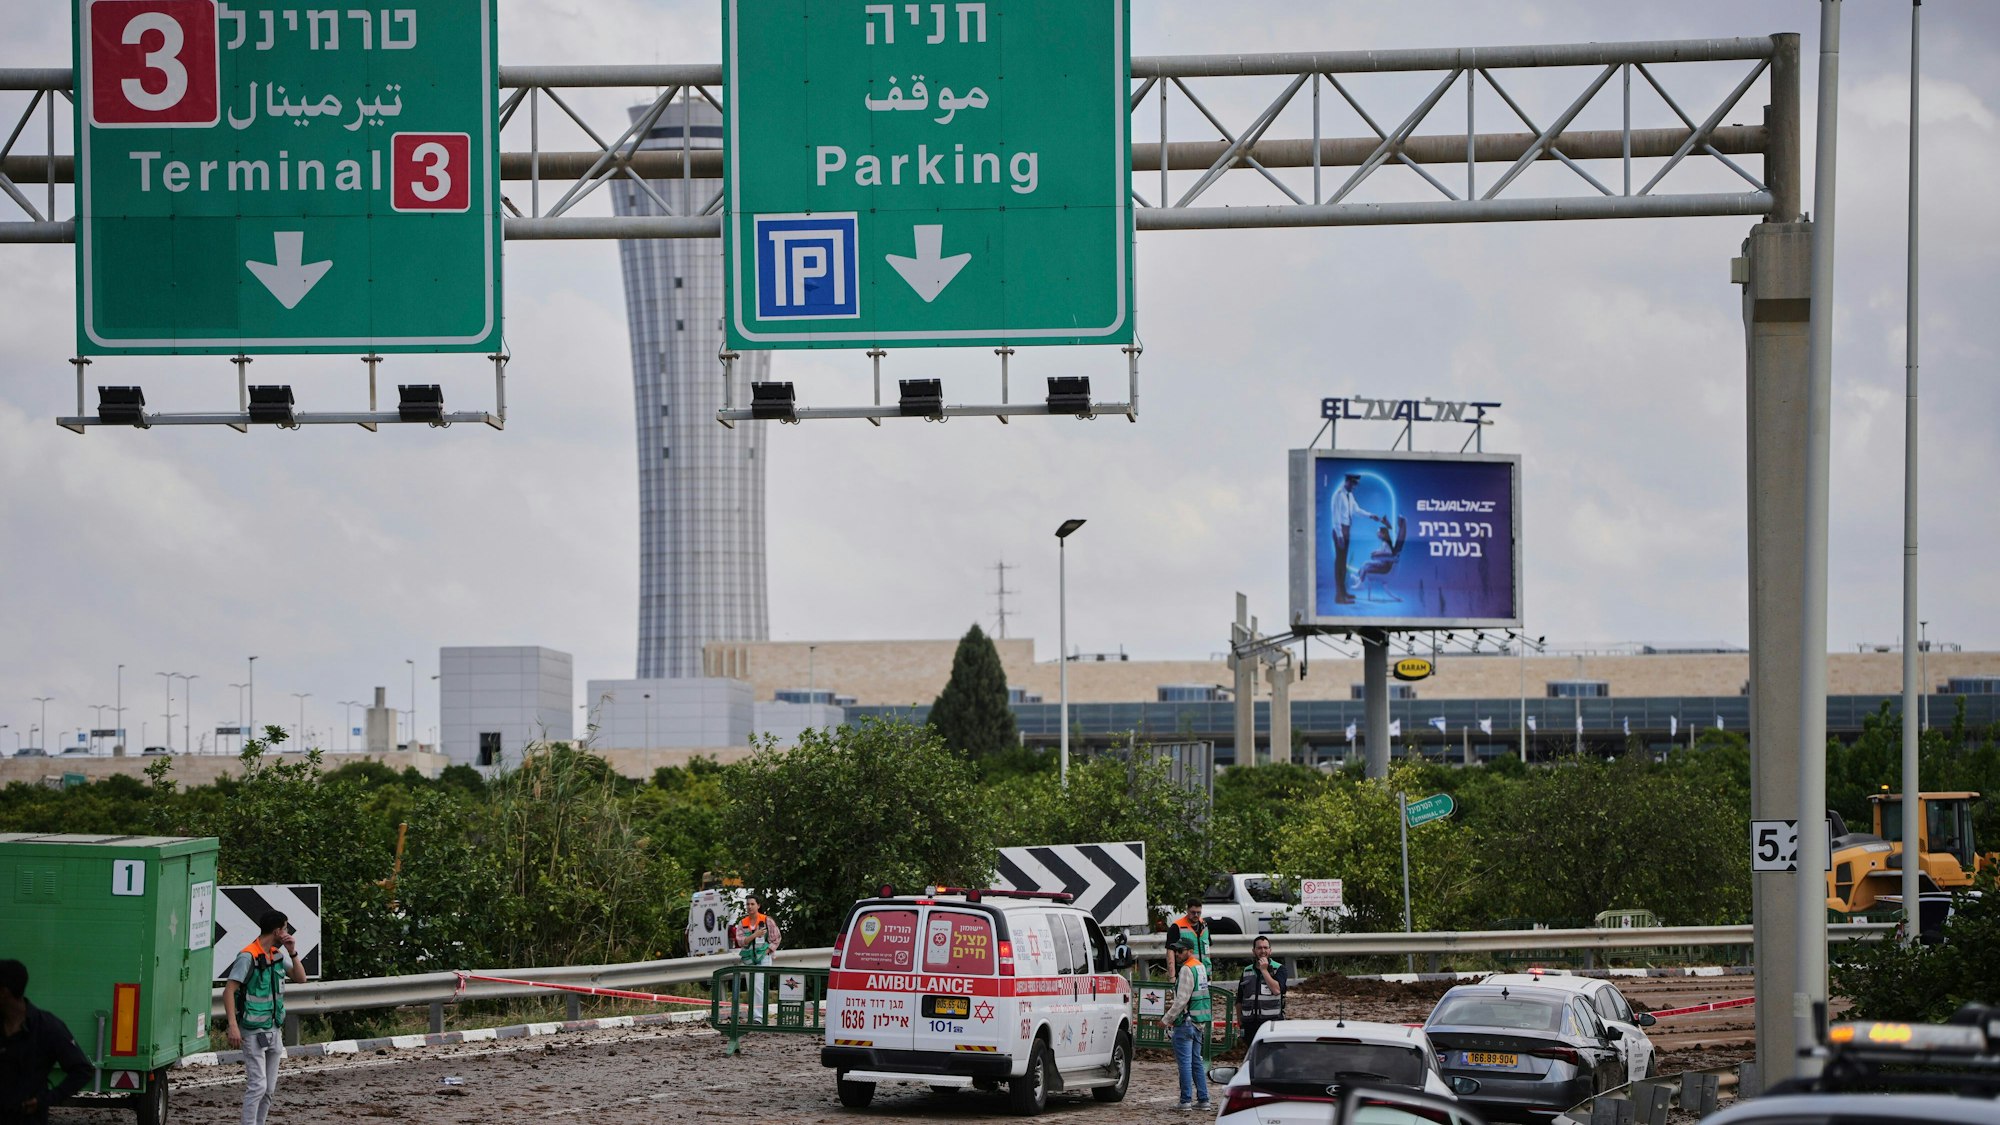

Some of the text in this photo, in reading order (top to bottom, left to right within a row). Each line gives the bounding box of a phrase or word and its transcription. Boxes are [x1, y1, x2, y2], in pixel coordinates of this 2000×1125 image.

[219, 3, 417, 51] טרמינל
[865, 2, 987, 45] חניה
[121, 11, 189, 111] 3
[227, 81, 403, 132] تيرمينال
[864, 74, 990, 125] موقف
[129, 142, 452, 202] Terminal 3
[816, 143, 1039, 194] Parking
[1418, 521, 1493, 538] הכי בבית
[1429, 540, 1482, 557] בעולם
[1401, 663, 1426, 671] BARAM
[125, 864, 133, 892] 1
[884, 924, 912, 934] הורידו
[698, 936, 722, 947] TOYOTA
[883, 935, 910, 943] עכשיו
[954, 931, 987, 946] מציל
[952, 946, 986, 959] חיים
[866, 974, 974, 994] AMBULANCE
[845, 997, 904, 1010] מגן דוד אדום
[841, 1009, 865, 1029] 1636
[873, 1013, 909, 1029] איילון
[929, 1020, 951, 1033] 101
